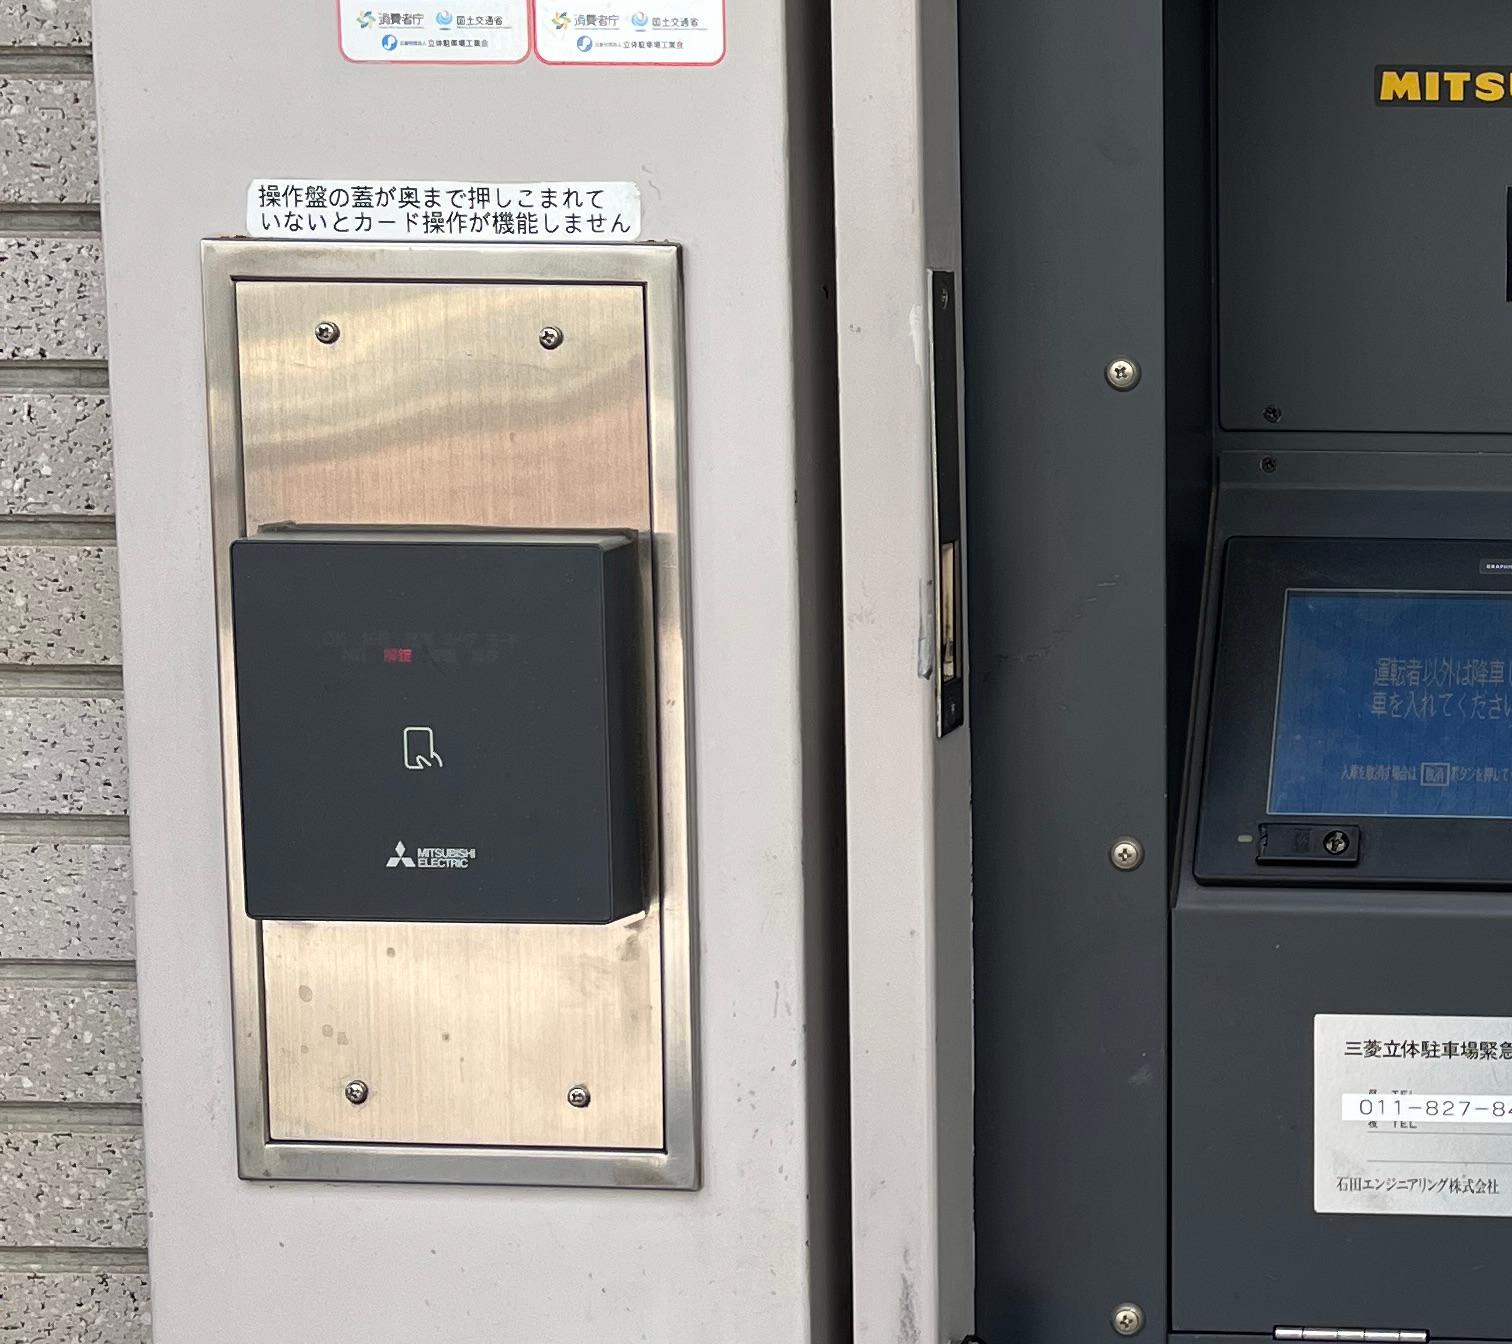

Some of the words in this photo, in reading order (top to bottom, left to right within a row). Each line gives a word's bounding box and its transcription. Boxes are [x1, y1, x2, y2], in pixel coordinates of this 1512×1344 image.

[259, 184, 605, 209] 操作盤の蓋が奥まで押しこまれて
[261, 210, 631, 235] いないとカード操作が機能しません
[417, 848, 476, 858] MITSUBISHI
[417, 858, 469, 868] ELECTRIC
[1336, 1176, 1501, 1195] 石田エンジニアリング株式会社
